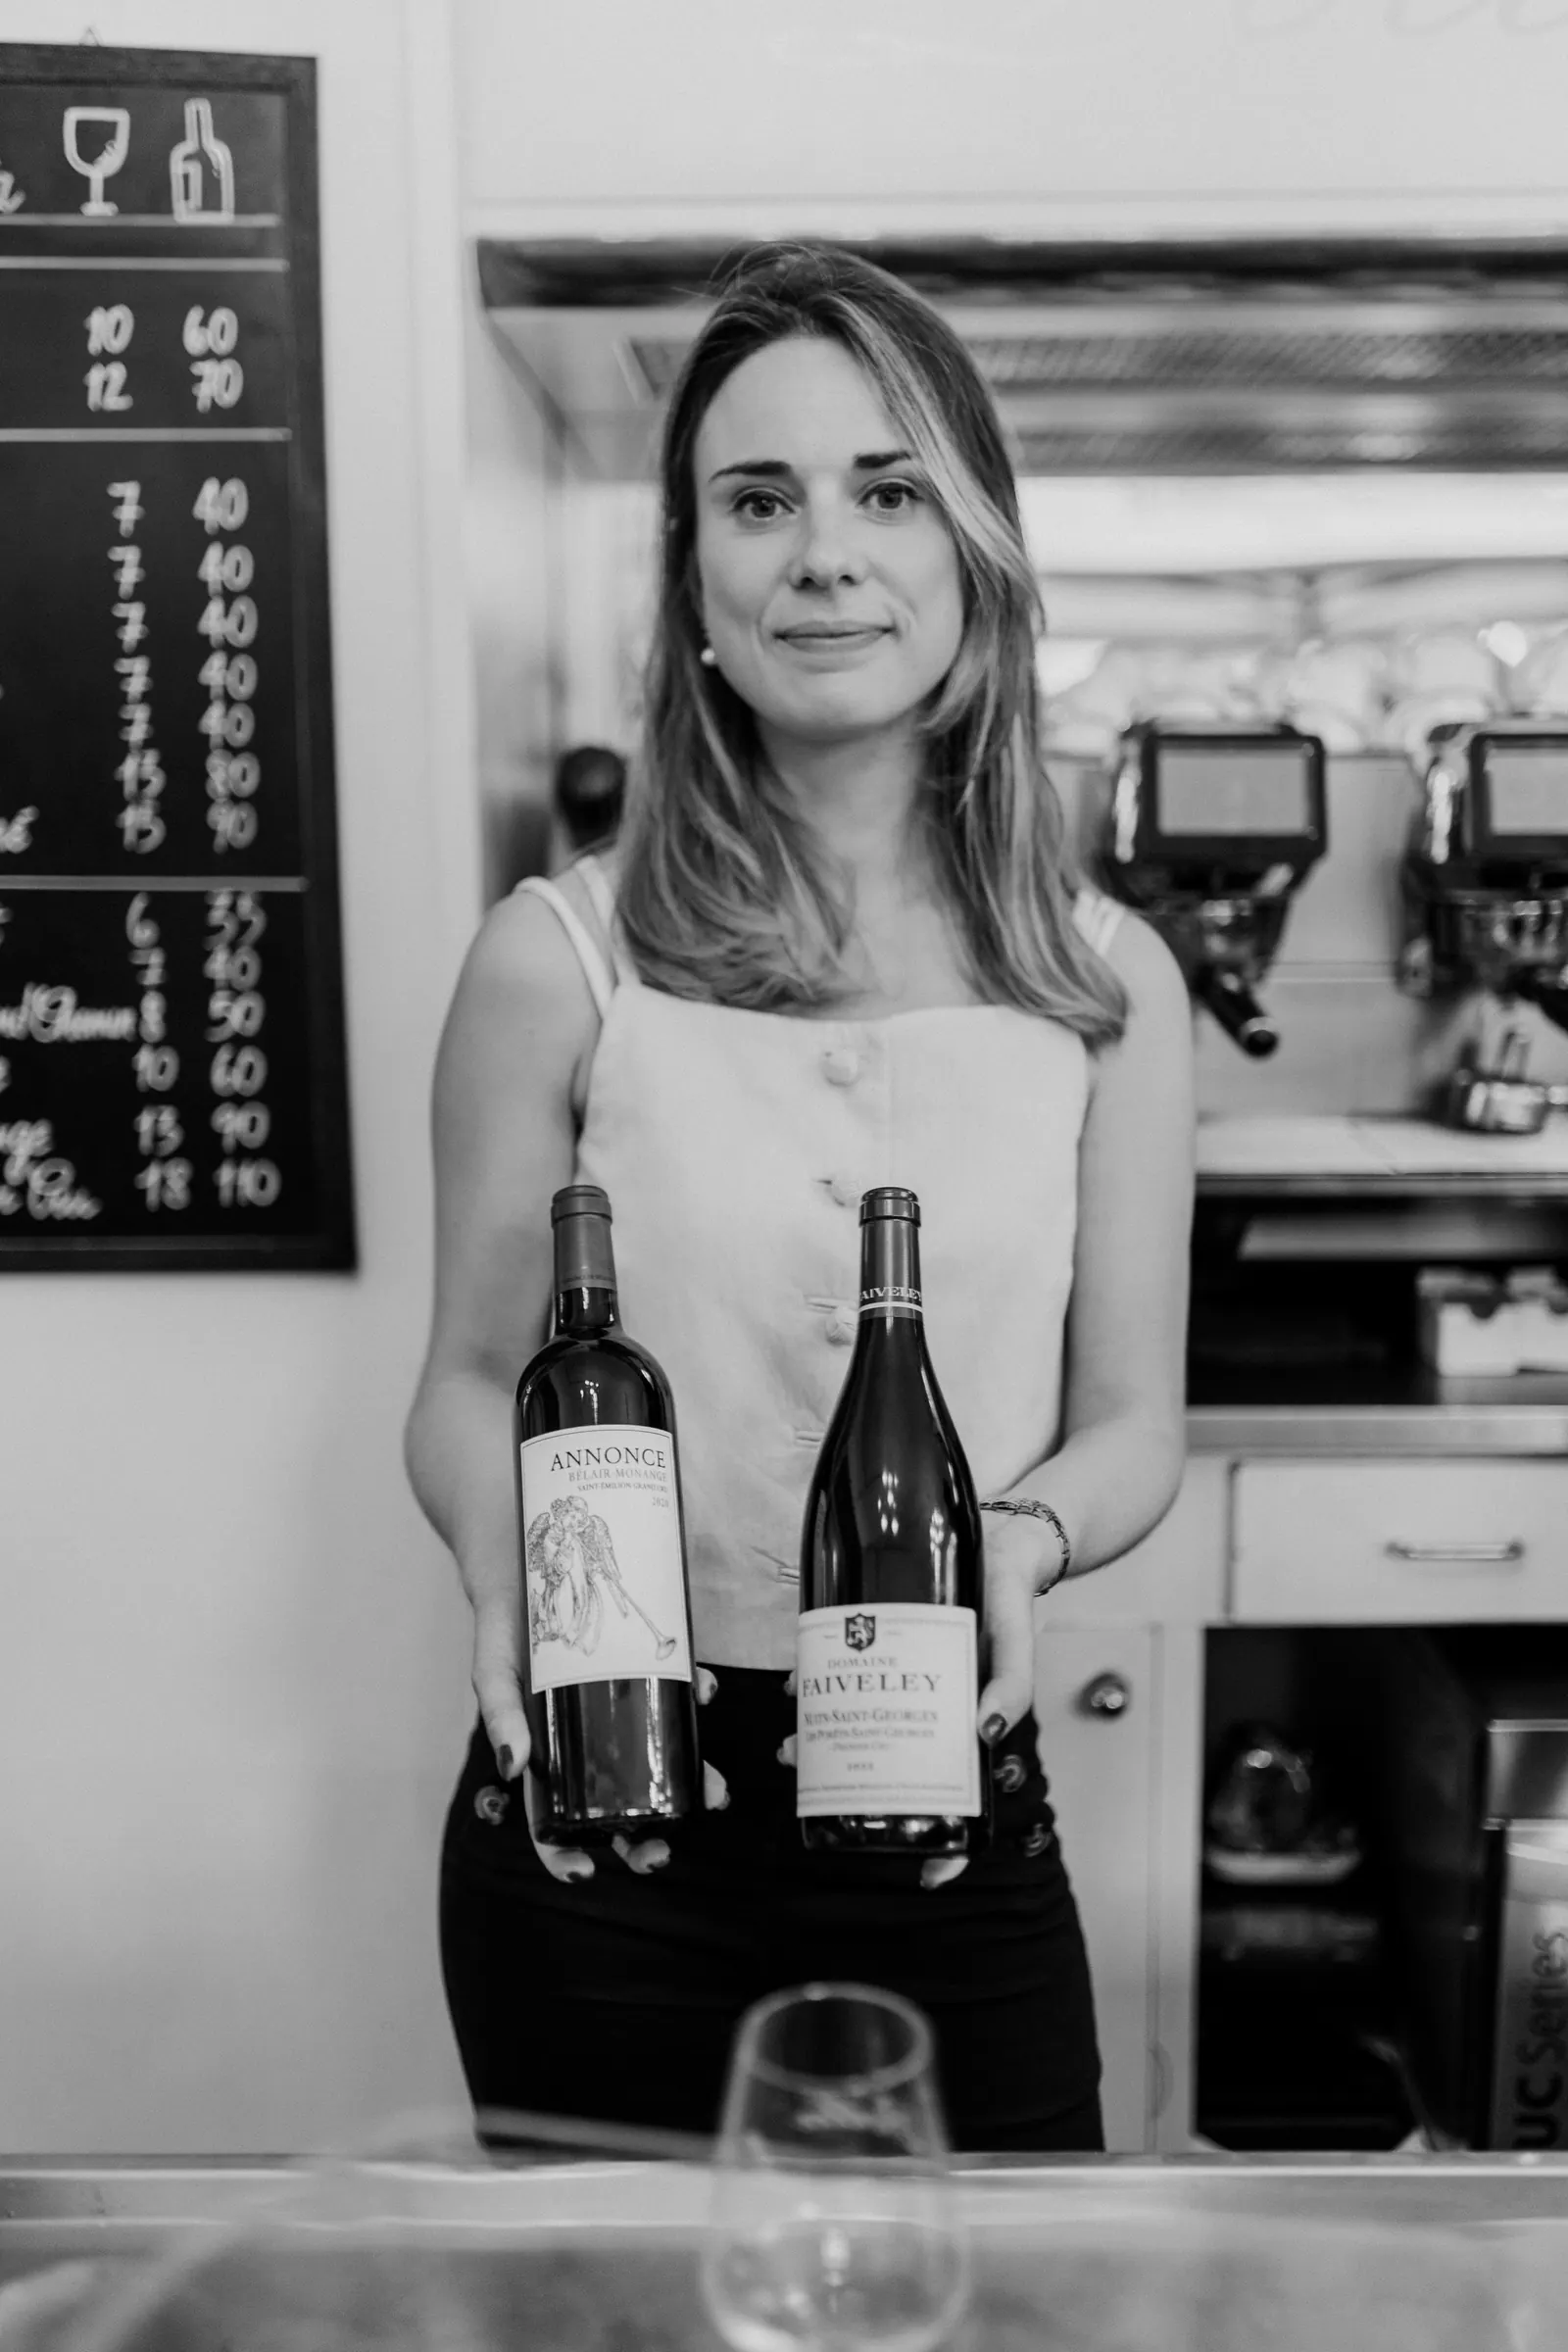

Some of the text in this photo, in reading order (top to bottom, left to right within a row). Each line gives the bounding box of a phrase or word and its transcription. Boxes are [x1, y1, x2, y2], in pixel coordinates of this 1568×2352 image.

[85, 305, 238, 356] 10 60
[85, 359, 243, 412] 12 70
[107, 476, 249, 537] 7 40
[107, 541, 255, 600] 7 40
[111, 595, 258, 653] 7 40
[114, 650, 258, 704] 7 40
[119, 700, 255, 750] 7 40
[115, 748, 167, 800] 15
[125, 891, 161, 949] 6
[204, 945, 262, 991] 40
[139, 990, 167, 1043] 8
[205, 990, 266, 1043] 50
[132, 1044, 268, 1097] 10 60
[211, 1101, 270, 1153] 90
[134, 1156, 193, 1212] 18
[214, 1158, 282, 1208] 110
[551, 1446, 666, 1471] ANNONCE
[803, 1674, 941, 1697] FAIVELEY
[827, 1656, 898, 1669] DOMAINE
[1513, 2072, 1562, 2149] UC
